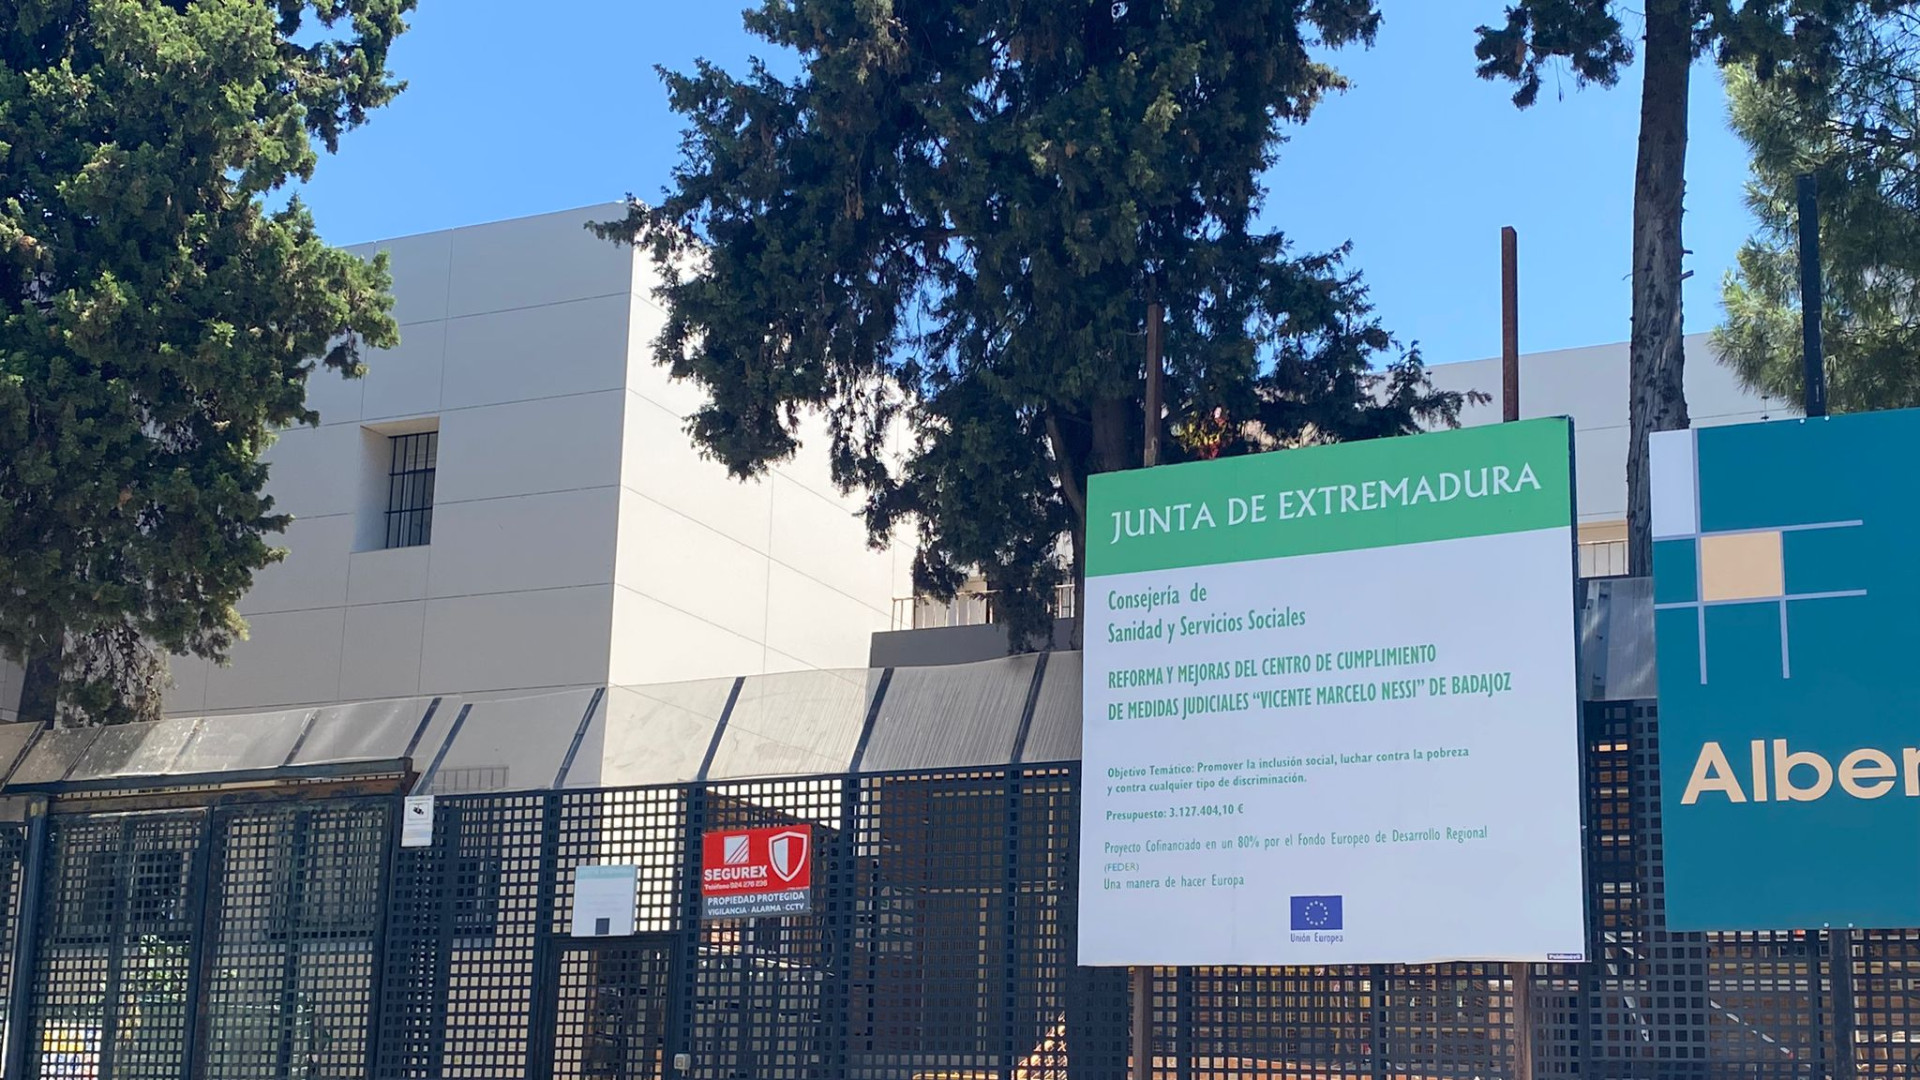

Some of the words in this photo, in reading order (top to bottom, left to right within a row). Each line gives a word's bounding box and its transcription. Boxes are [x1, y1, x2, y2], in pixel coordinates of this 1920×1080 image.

[1110, 501, 1217, 545] JUNTA
[1227, 493, 1267, 526] DE
[1279, 462, 1542, 520] EXTREMADURA
[1108, 585, 1180, 613] Consejería
[1190, 582, 1207, 602] de
[1108, 618, 1162, 643] Sanidad
[1167, 623, 1175, 644] y
[1180, 612, 1243, 636] Servicios
[1248, 606, 1306, 630] Sociales
[1108, 667, 1163, 689] REFORMA
[1166, 666, 1174, 684] Y
[1178, 661, 1230, 687] MEJORAS
[1235, 659, 1257, 678] DEL
[1262, 654, 1311, 676] CENTRO
[1316, 653, 1332, 672] DE
[1337, 644, 1437, 670] CUMPLIMIENTO
[1108, 703, 1124, 721] DE
[1128, 697, 1179, 719] MEDIDAS
[1182, 692, 1249, 720] JUDICIALES
[1252, 687, 1311, 709] “VICENTE
[1316, 683, 1376, 705] MARCELO
[1381, 679, 1425, 700] NESSI”
[1429, 677, 1446, 696] DE
[1452, 672, 1511, 698] BADAJOZ
[1107, 767, 1146, 780] Objetivo
[1149, 765, 1194, 776] Temático:
[1197, 761, 1243, 773] Promover
[1246, 759, 1256, 770] la
[1259, 756, 1302, 769] inclusión
[1305, 754, 1338, 766] social,
[1340, 753, 1372, 764] luchar
[1376, 751, 1410, 762] contra
[1413, 749, 1423, 760] la
[1427, 747, 1469, 761] pobreza
[1107, 785, 1113, 796] y
[1115, 784, 1146, 793] contra
[1149, 781, 1193, 793] cualquier
[1196, 779, 1215, 791] tipo
[1218, 777, 1230, 787] de
[1233, 773, 1307, 786] discriminación.
[1106, 810, 1167, 822] Presupuesto:
[1169, 804, 1234, 817] 3.127.404,10
[1237, 803, 1244, 814] €
[1104, 841, 1141, 857] Proyecto
[1145, 839, 1201, 853] Cofinanciado
[1205, 840, 1217, 850] en
[1221, 839, 1233, 849] un
[1237, 835, 1260, 849] 80%
[1264, 837, 1280, 850] por
[1285, 834, 1293, 846] el
[1298, 833, 1326, 846] Fondo
[1331, 832, 1370, 848] Europeo
[1375, 830, 1387, 843] de
[1392, 828, 1441, 842] Desarrollo
[1446, 825, 1488, 843] Regional
[704, 865, 768, 882] SEGUREX
[1104, 862, 1140, 873] (FEDER)
[1104, 878, 1121, 890] Una
[1126, 878, 1160, 889] manera
[1164, 875, 1176, 888] de
[1181, 875, 1206, 888] hacer
[1211, 874, 1245, 889] Europa
[707, 895, 756, 907] PROPIEDAD
[757, 891, 805, 903] PROTEGIDA
[708, 908, 747, 917] VIGILANCIA
[751, 904, 782, 914] ALARMA
[785, 903, 804, 912] CCTV
[1290, 932, 1311, 943] Unión
[1314, 932, 1344, 945] Europea
